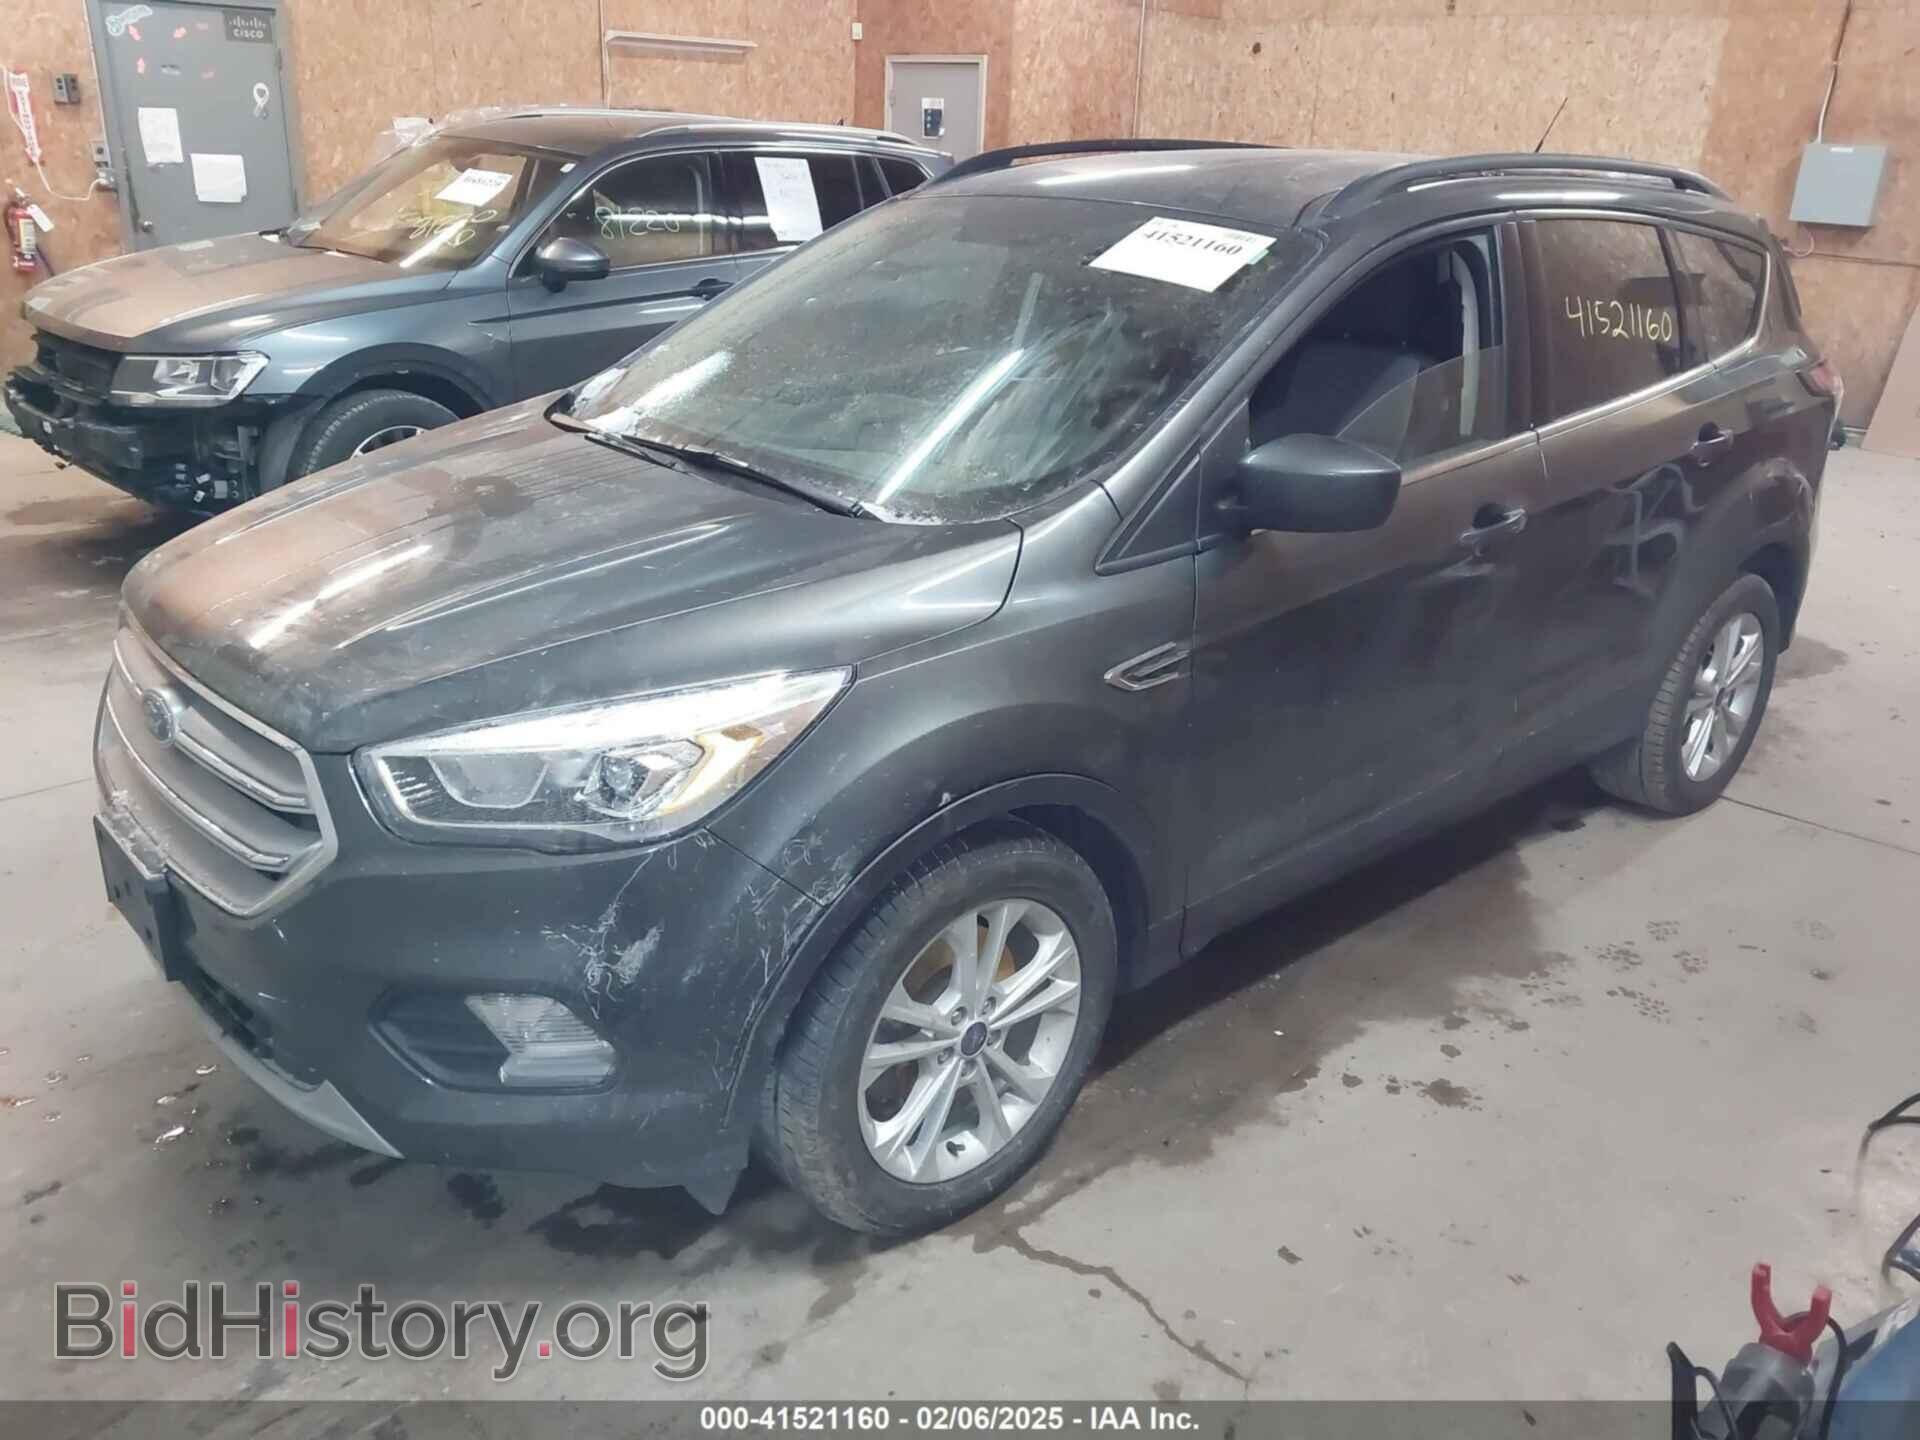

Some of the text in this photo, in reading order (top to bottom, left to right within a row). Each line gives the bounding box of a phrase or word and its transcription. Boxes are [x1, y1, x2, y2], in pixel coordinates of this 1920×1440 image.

[233, 28, 265, 39] cisco
[1144, 229, 1243, 256] 41521160
[1565, 295, 1672, 341] 41521160
